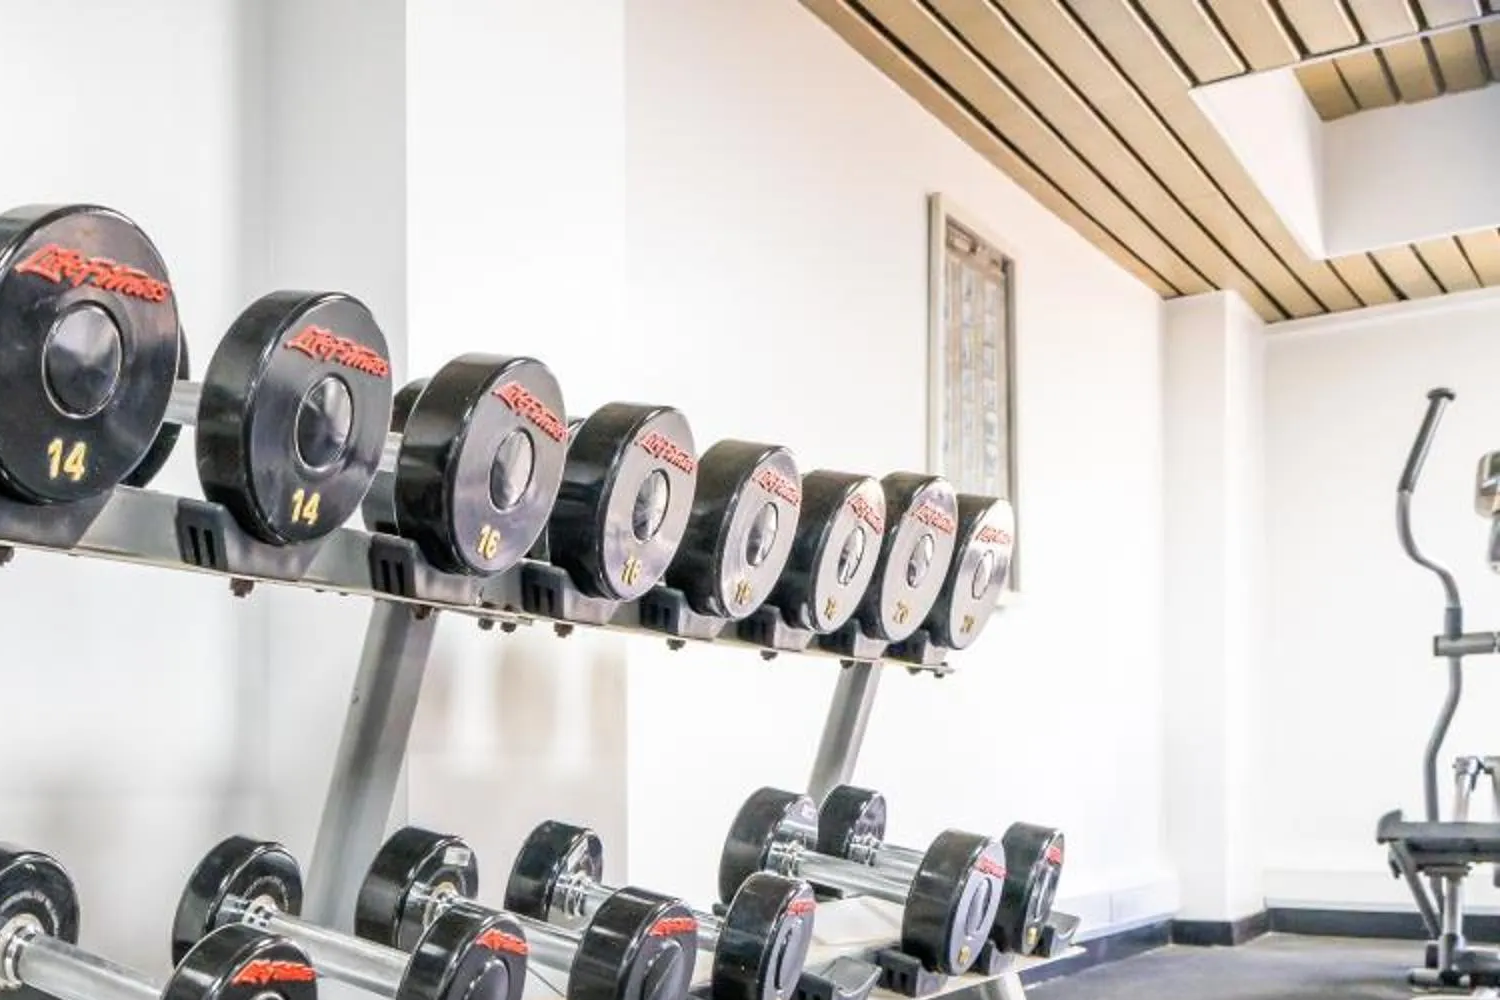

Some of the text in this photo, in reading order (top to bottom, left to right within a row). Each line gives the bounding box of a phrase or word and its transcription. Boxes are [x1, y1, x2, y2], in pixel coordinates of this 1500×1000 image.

[46, 437, 90, 482] 14
[291, 488, 320, 526] 14
[475, 524, 500, 561] 16
